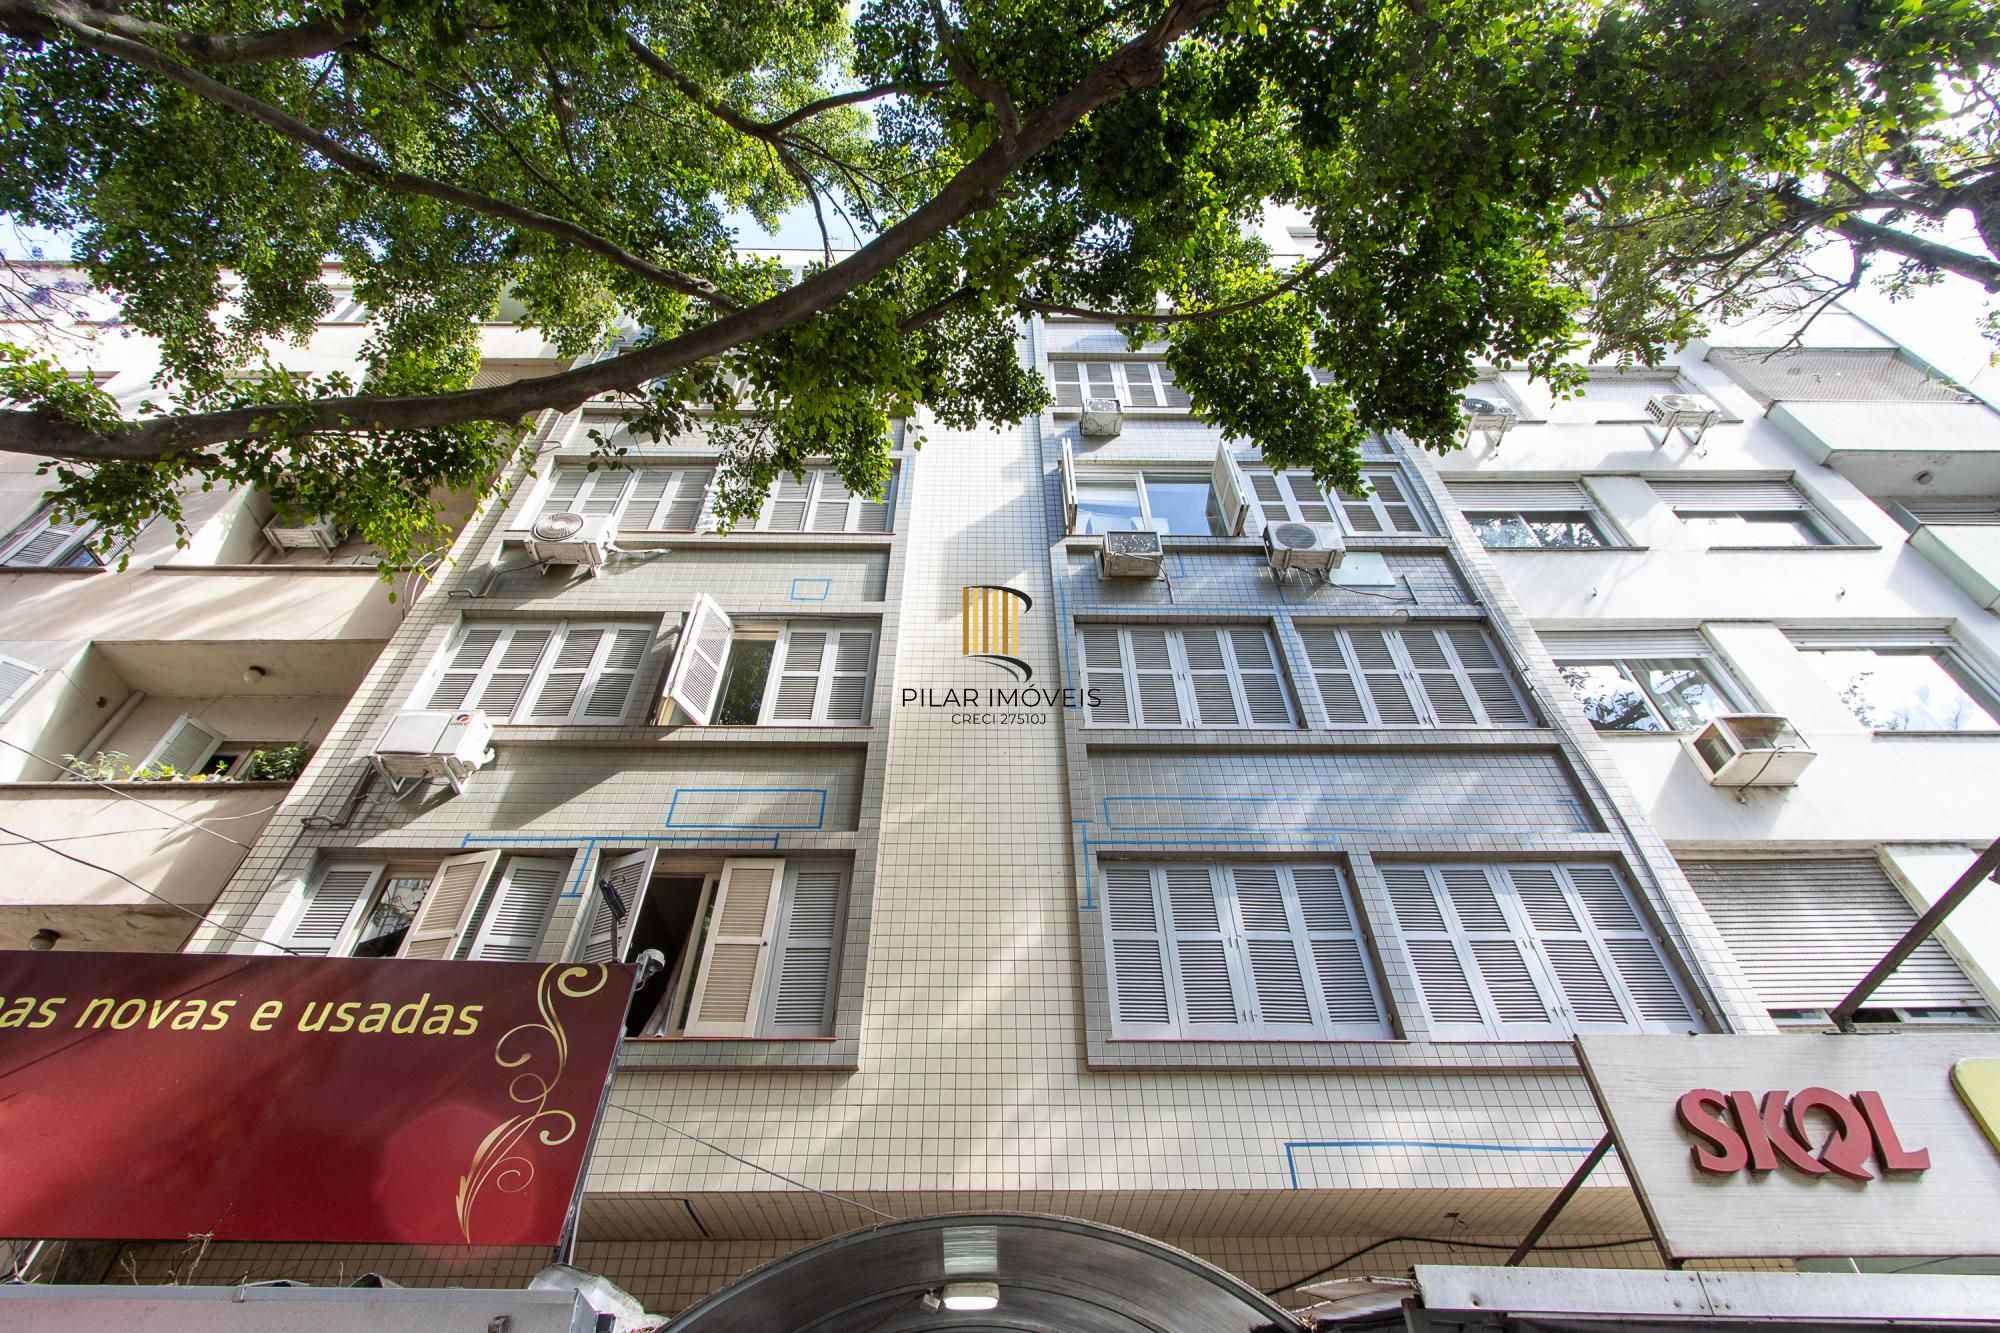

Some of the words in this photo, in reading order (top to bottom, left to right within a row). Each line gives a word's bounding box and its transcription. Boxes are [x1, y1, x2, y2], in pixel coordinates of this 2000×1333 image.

[0, 996, 67, 1029] as
[74, 997, 238, 1031] novas
[250, 1000, 283, 1032] e
[297, 992, 484, 1036] usadas
